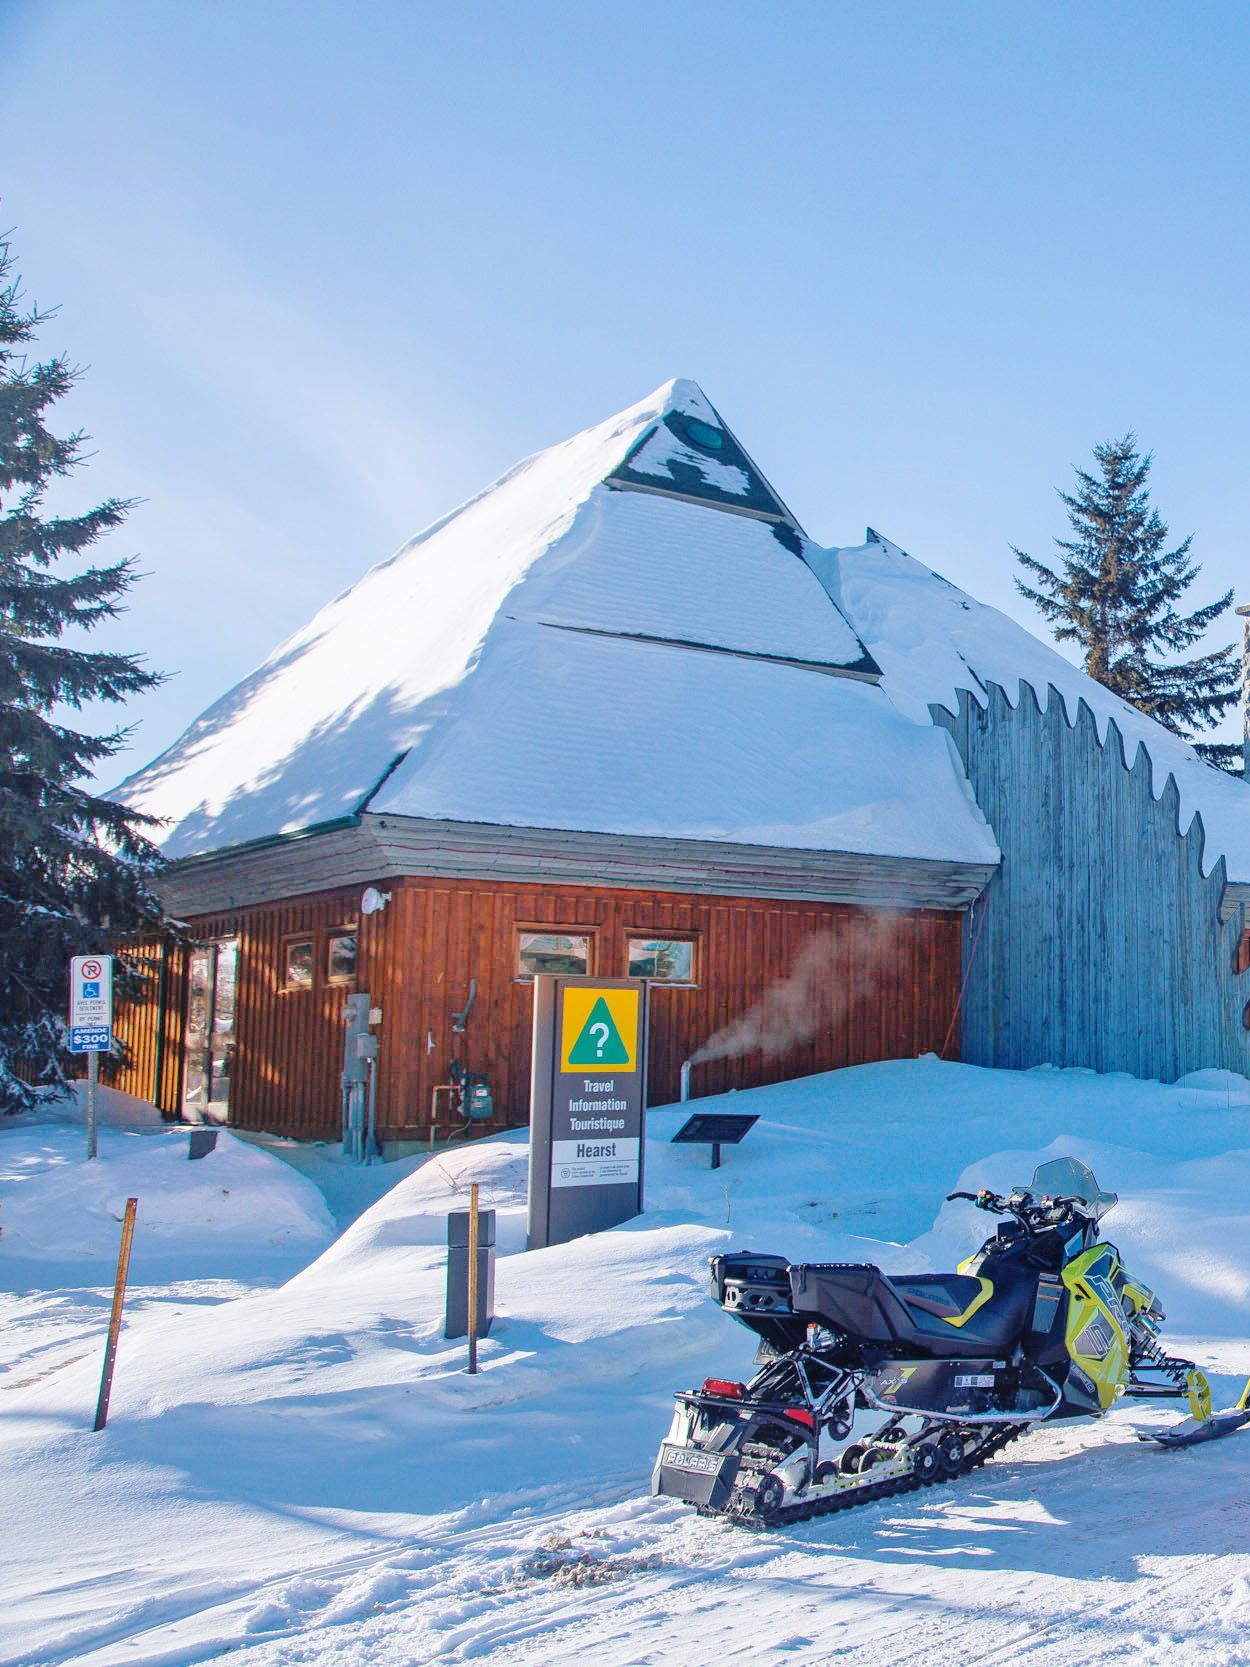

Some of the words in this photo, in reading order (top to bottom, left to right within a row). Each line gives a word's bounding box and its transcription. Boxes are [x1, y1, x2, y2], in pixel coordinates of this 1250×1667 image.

[73, 1034, 108, 1045] $300
[583, 1079, 614, 1093] Travel
[568, 1098, 627, 1112] Information
[569, 1117, 625, 1132] Touristique
[576, 1142, 617, 1158] Hearst
[666, 1452, 718, 1472] POLARIS
